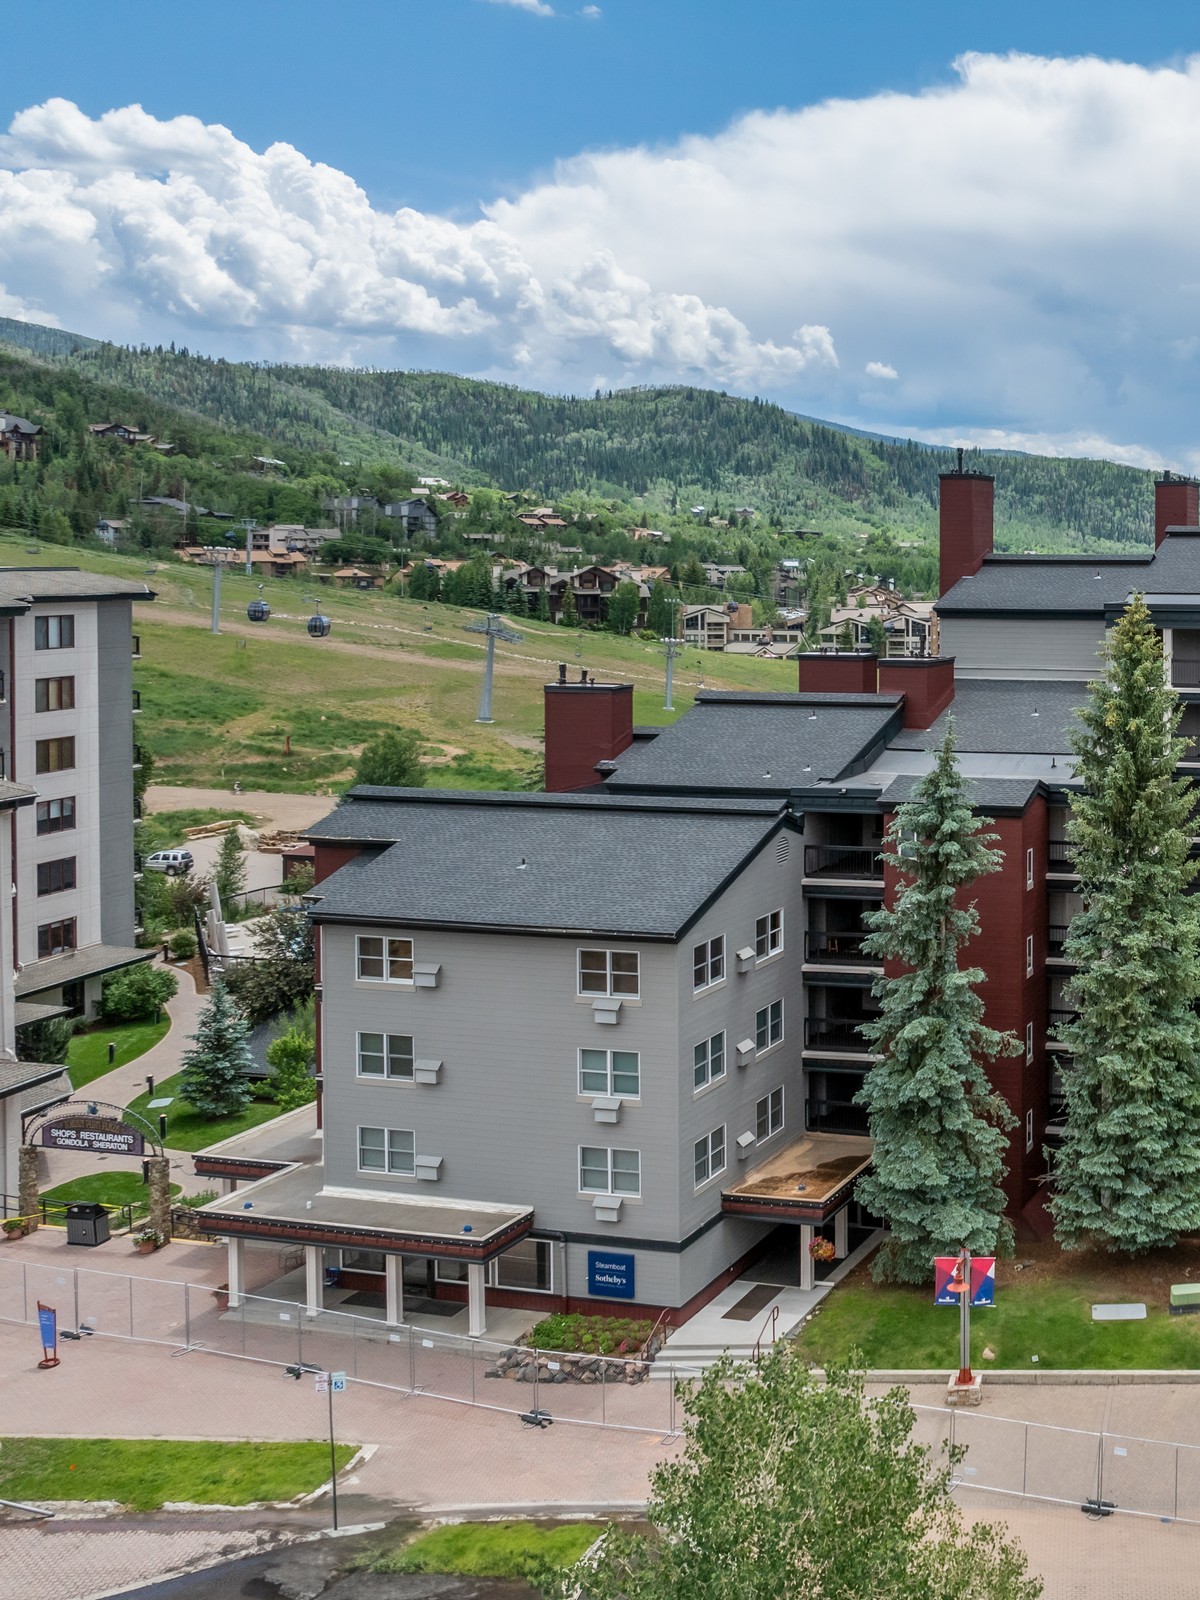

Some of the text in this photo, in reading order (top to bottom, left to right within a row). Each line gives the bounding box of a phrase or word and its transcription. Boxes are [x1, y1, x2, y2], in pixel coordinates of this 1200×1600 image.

[50, 1128, 134, 1144] SHOPS RESTAURANTS
[56, 1138, 128, 1151] GONDOLA SHERATON
[595, 1261, 626, 1271] Steamboat
[595, 1274, 627, 1285] Sotheby's
